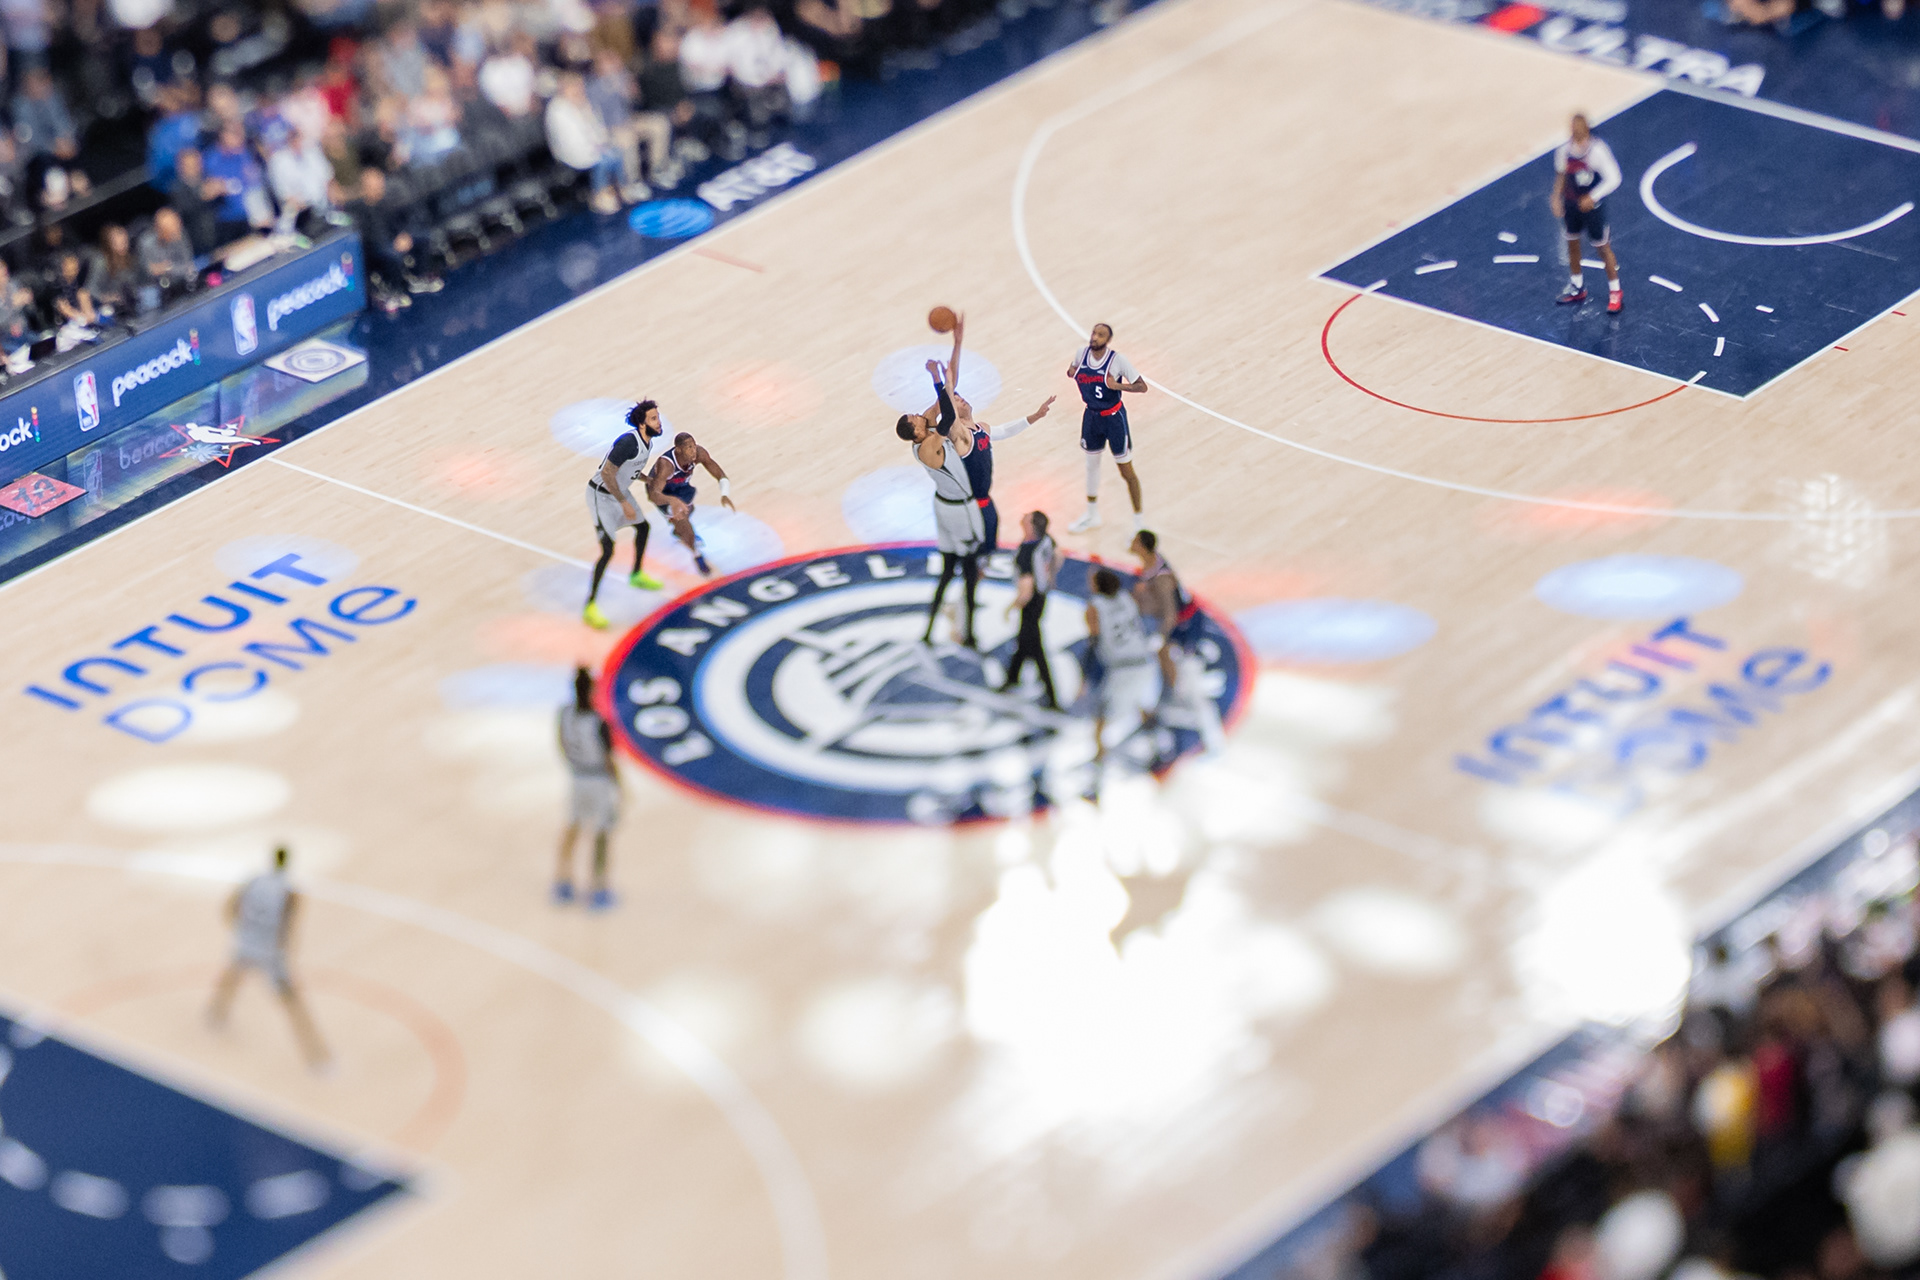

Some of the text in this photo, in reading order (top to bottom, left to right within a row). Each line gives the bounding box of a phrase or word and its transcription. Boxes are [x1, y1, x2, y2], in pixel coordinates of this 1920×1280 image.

[112, 338, 193, 407] peacock
[1095, 385, 1103, 398] 5
[627, 676, 714, 767] LOS
